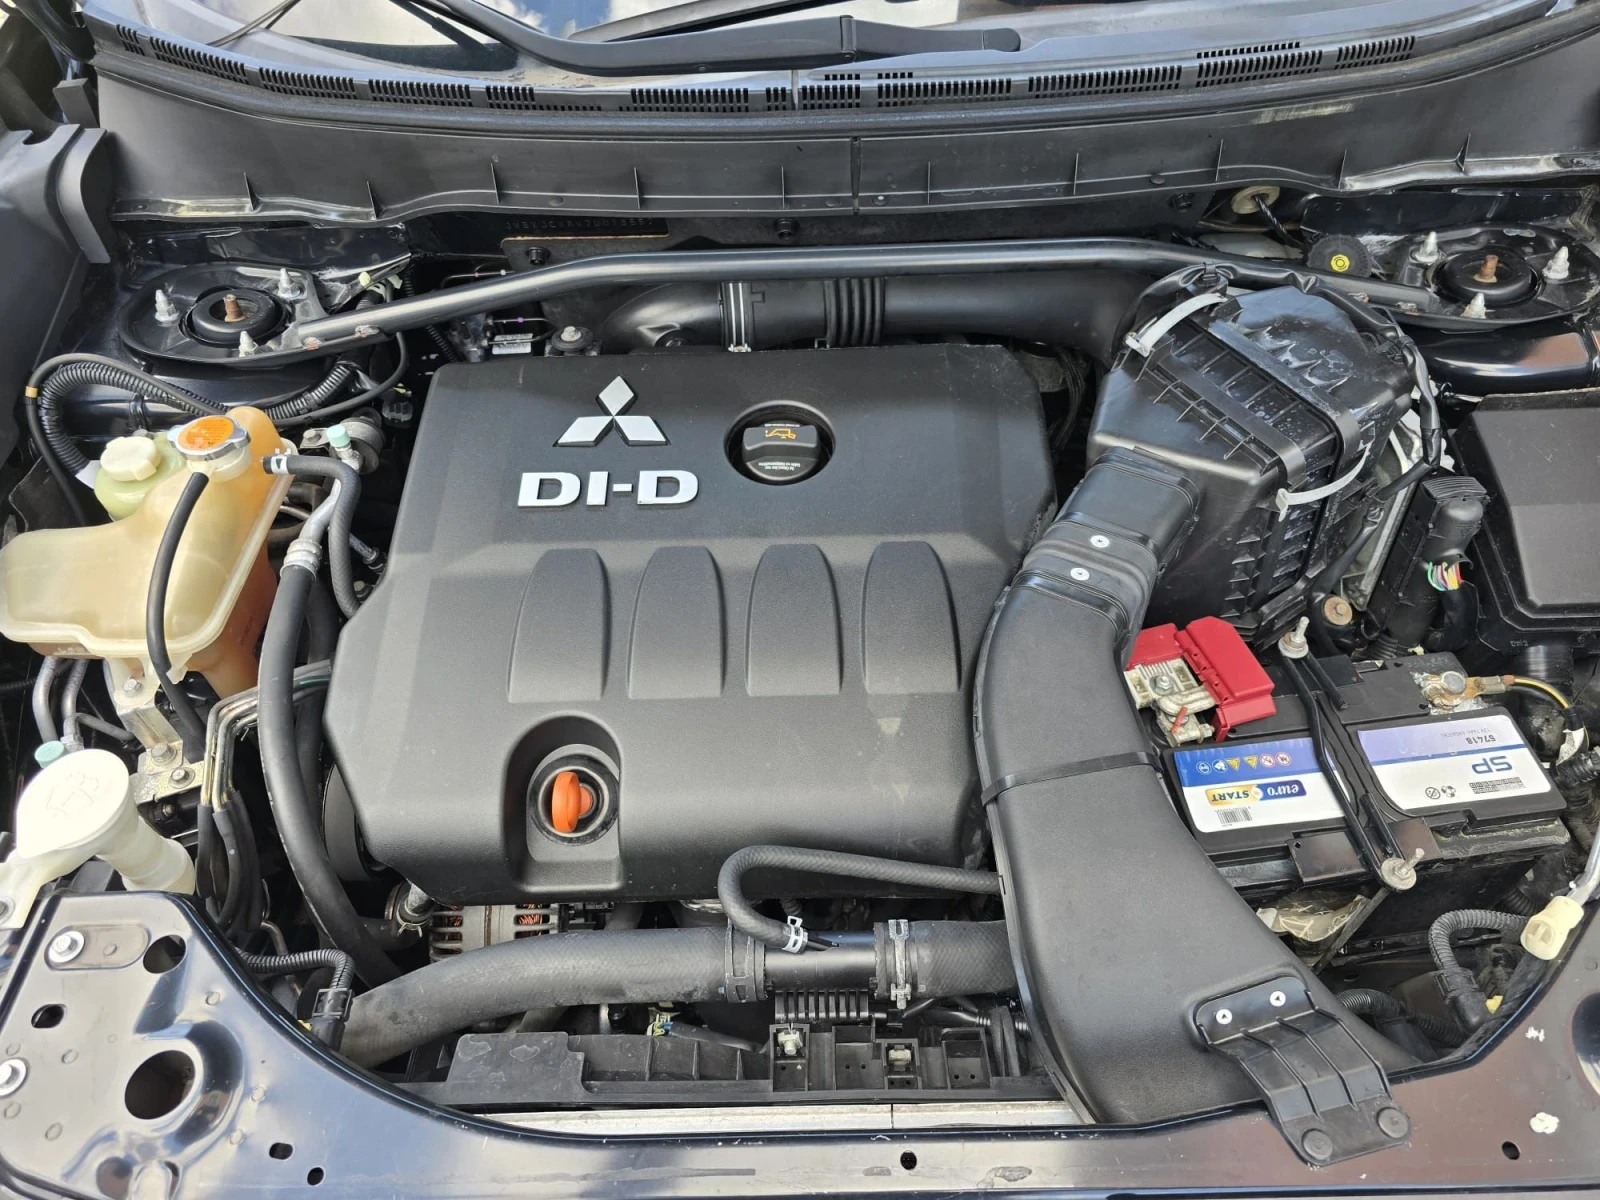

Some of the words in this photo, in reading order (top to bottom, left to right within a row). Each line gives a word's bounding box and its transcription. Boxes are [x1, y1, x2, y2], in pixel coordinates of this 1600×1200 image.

[518, 470, 698, 507] DI-D
[1466, 735, 1496, 744] 57418
[1472, 756, 1513, 774] SP
[1212, 790, 1250, 802] START
[1267, 784, 1299, 796] euro
